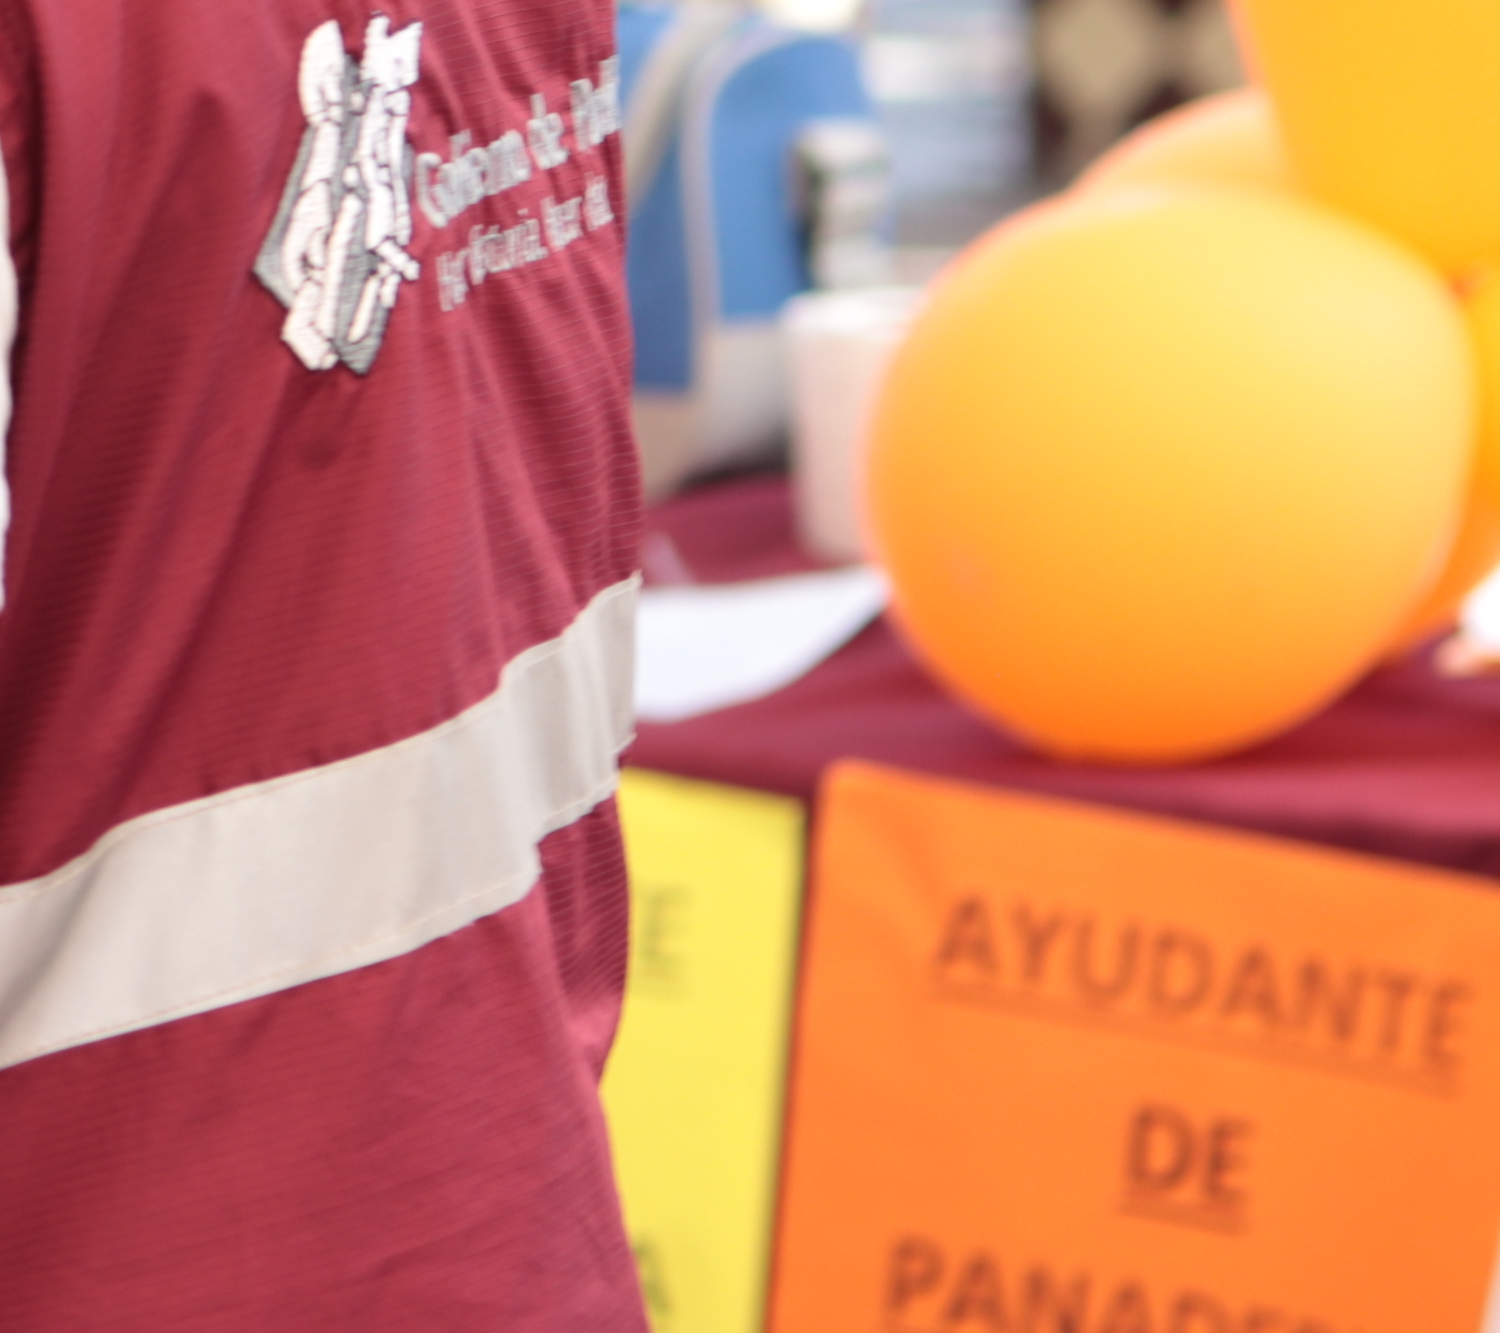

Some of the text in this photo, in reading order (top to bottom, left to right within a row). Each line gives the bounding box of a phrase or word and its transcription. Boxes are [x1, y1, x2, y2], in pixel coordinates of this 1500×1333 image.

[638, 881, 695, 981] E
[934, 893, 1474, 1071] AYUDANTE
[1122, 1103, 1254, 1203] DE
